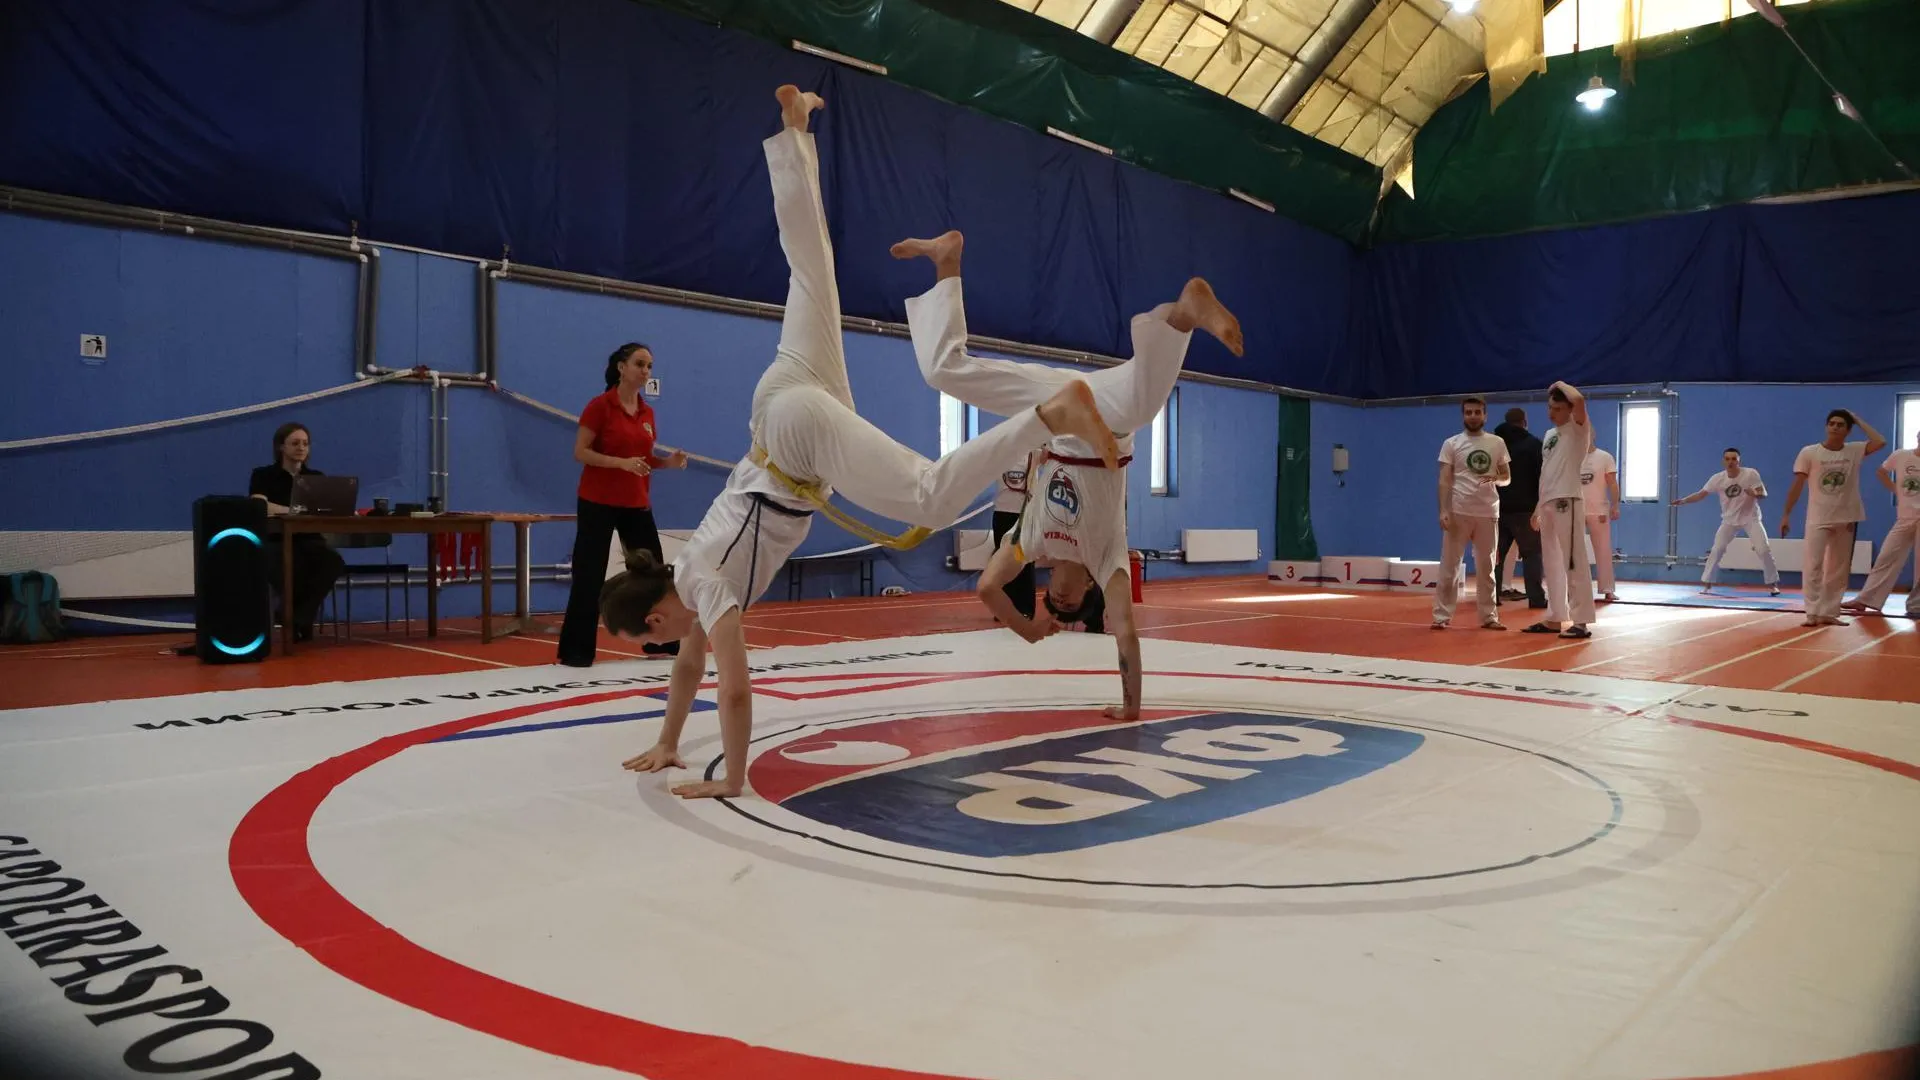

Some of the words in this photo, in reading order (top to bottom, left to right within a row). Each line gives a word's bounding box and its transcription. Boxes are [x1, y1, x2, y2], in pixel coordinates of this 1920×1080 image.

[1286, 565, 1295, 579] 3
[1343, 562, 1351, 581] 1
[1411, 568, 1422, 584] 2
[133, 697, 433, 731] РОССИИ
[952, 724, 1350, 825] ФКР
